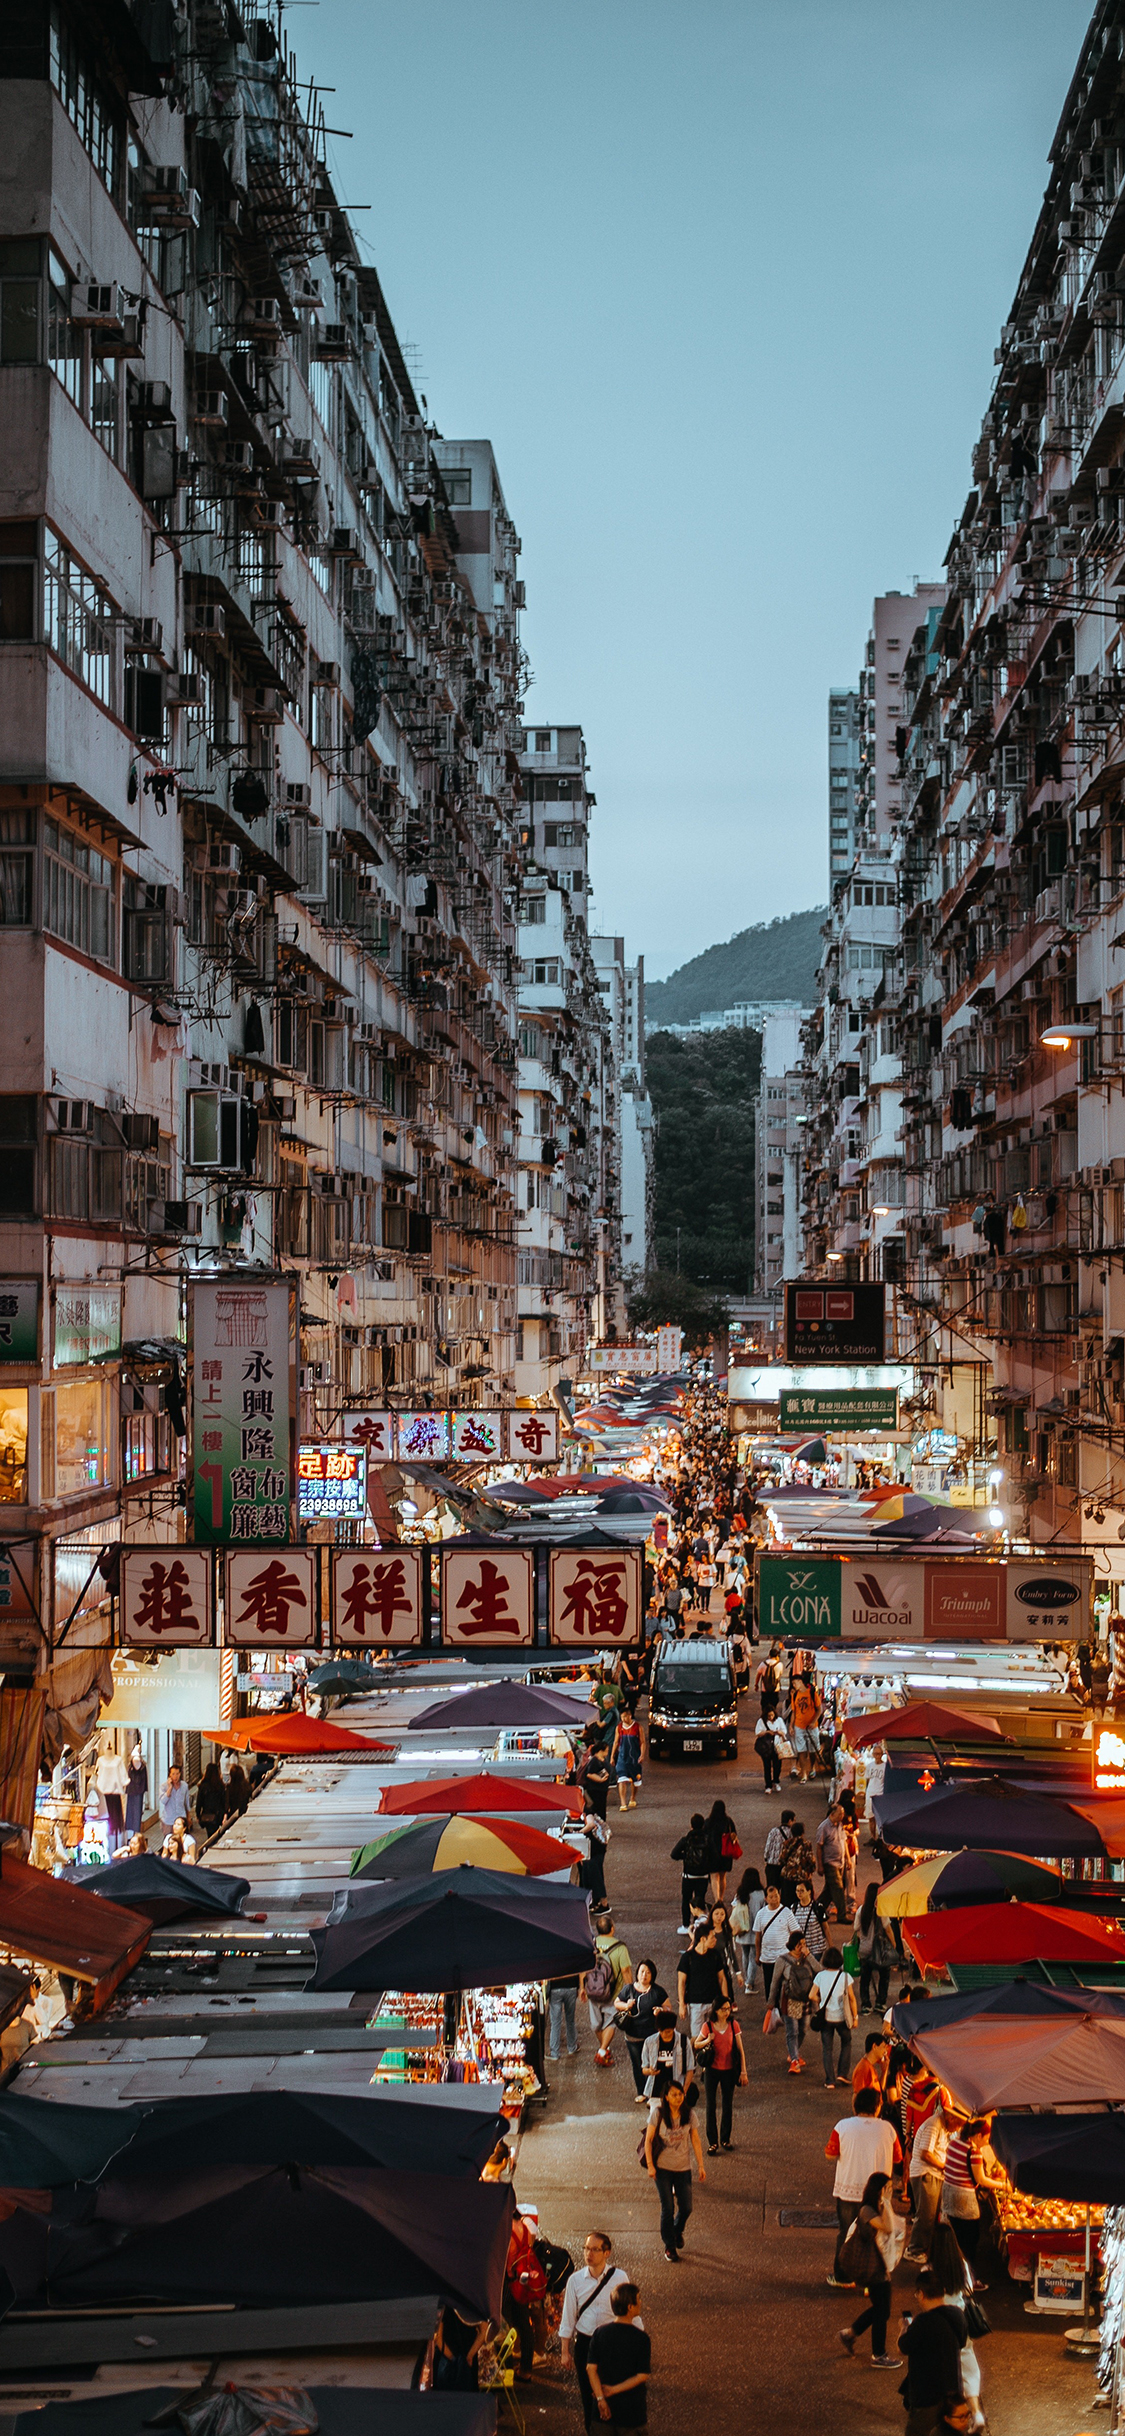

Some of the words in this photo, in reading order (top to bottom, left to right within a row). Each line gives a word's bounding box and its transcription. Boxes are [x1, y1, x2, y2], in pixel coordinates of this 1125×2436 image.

[794, 1345, 816, 1354] New
[819, 1345, 841, 1354] York
[843, 1345, 877, 1354] Station
[201, 1360, 223, 1452] 請上一樓
[298, 1453, 356, 1479] 足跡
[1021, 1589, 1048, 1601] Embry
[1052, 1589, 1075, 1600] Form
[770, 1596, 832, 1625] LEONA
[939, 1595, 991, 1612] Triumph
[852, 1609, 912, 1625] Wacoal
[1026, 1614, 1070, 1626] 安莉芳
[1044, 2278, 1075, 2289] Sunkist
